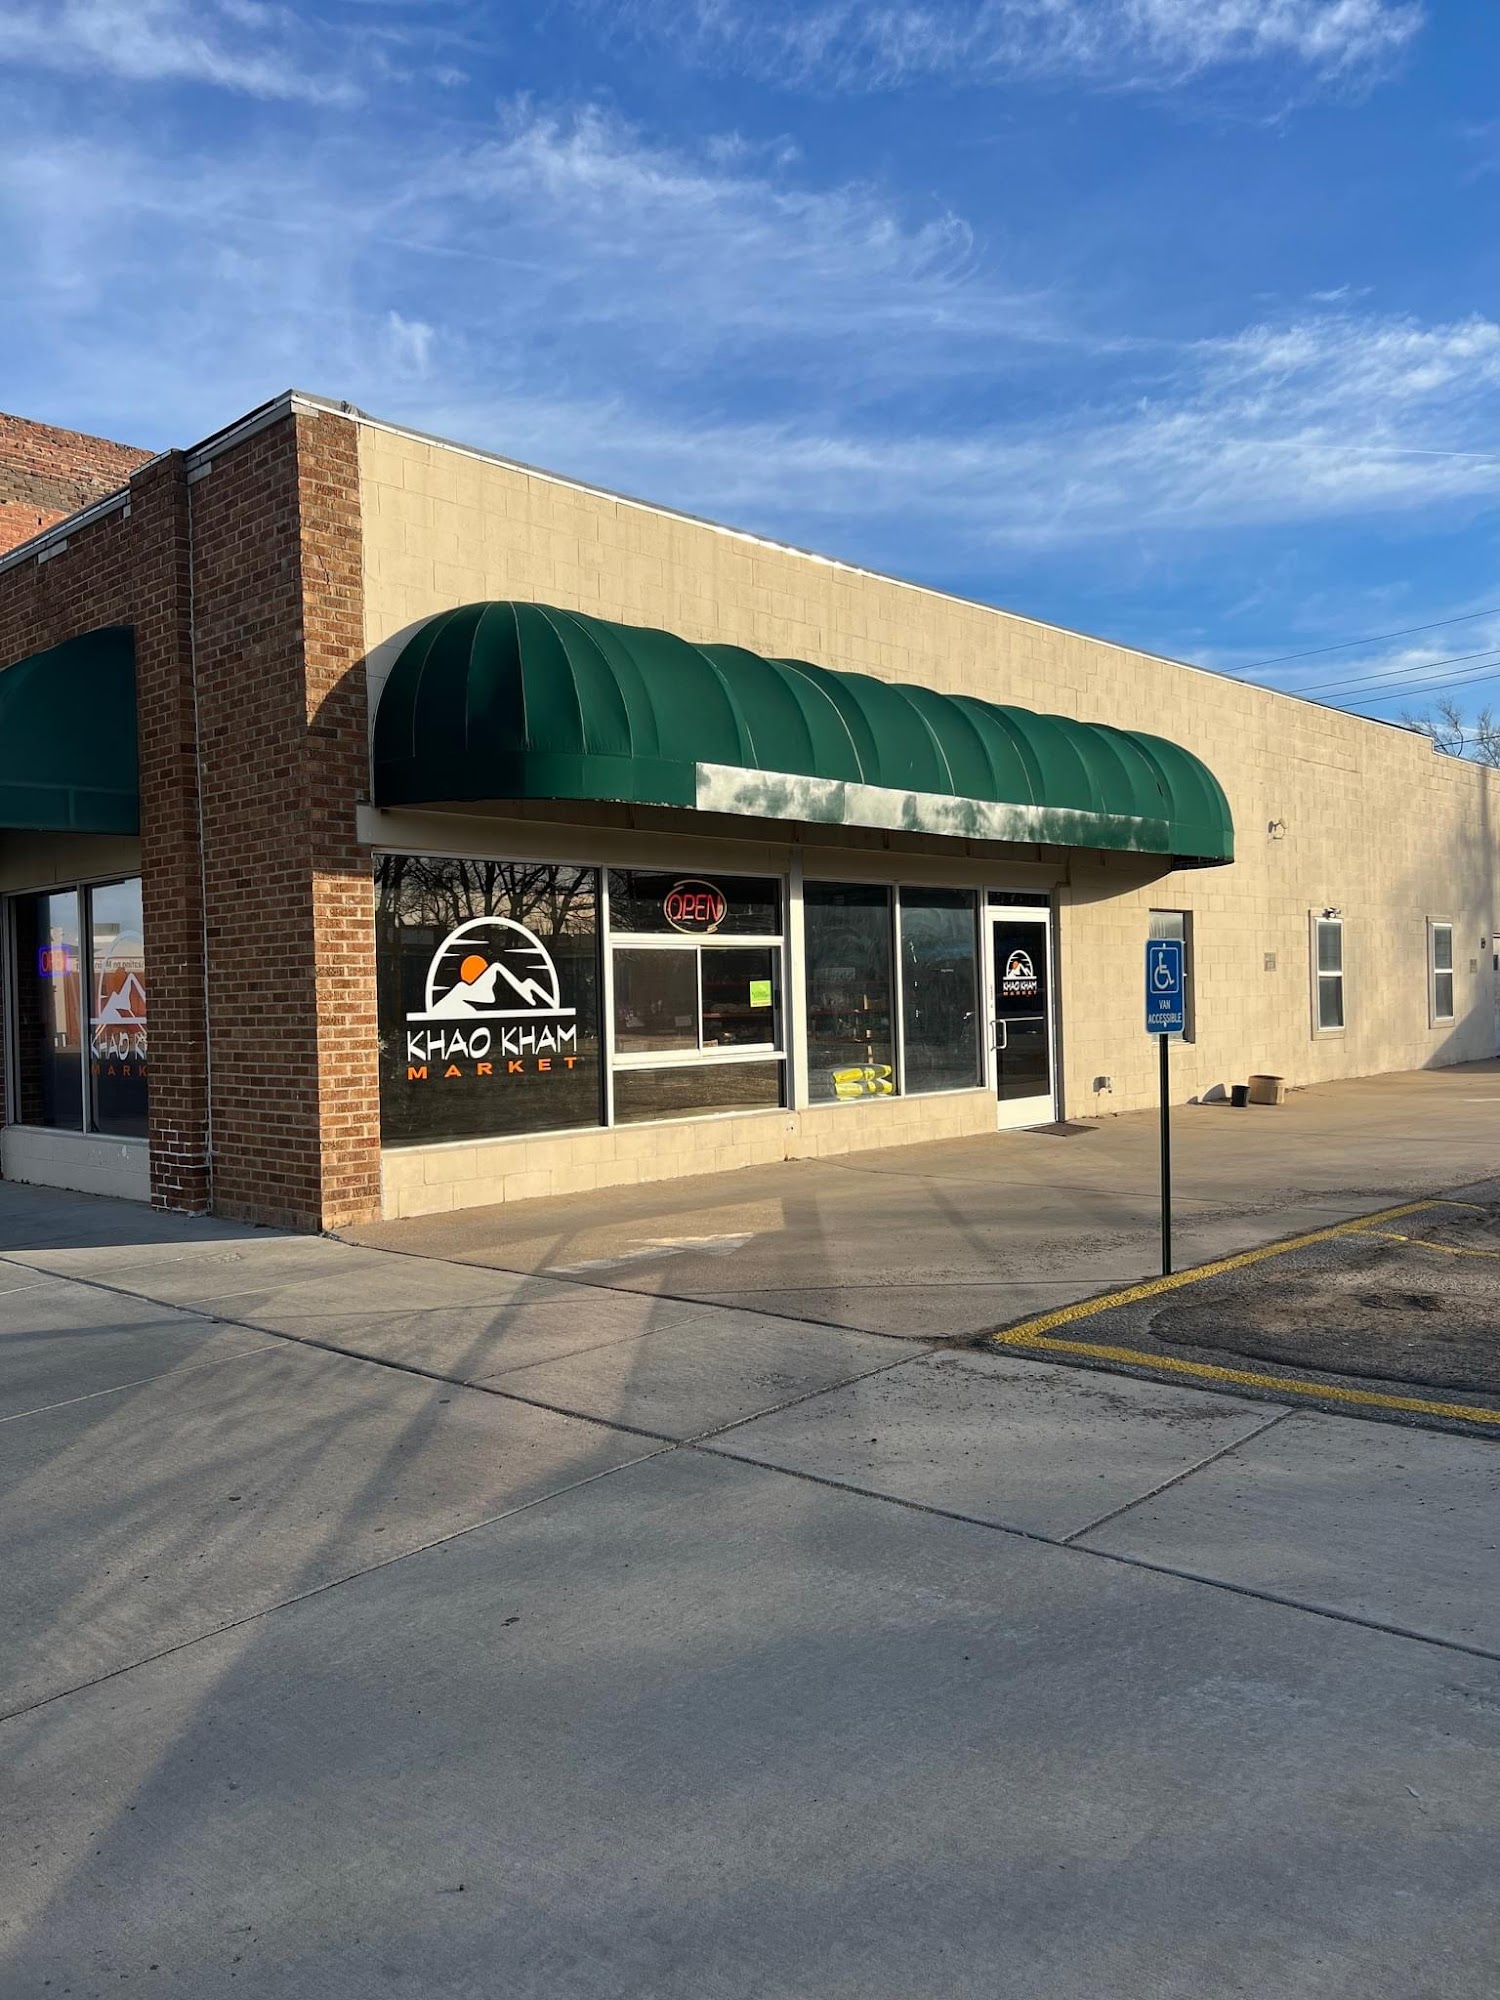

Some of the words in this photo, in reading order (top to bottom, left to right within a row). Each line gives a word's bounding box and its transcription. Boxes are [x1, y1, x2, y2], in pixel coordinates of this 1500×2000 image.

[668, 894, 723, 921] OPEN
[1003, 981, 1020, 991] KHAO
[1020, 980, 1037, 990] KHAM
[1159, 999, 1171, 1009] VAN
[1148, 1012, 1182, 1024] ACCESSIBLE
[91, 1033, 129, 1060] KHAO
[407, 1027, 491, 1062] KHAO
[501, 1024, 576, 1056] KHAM
[407, 1057, 577, 1080] MARKET
